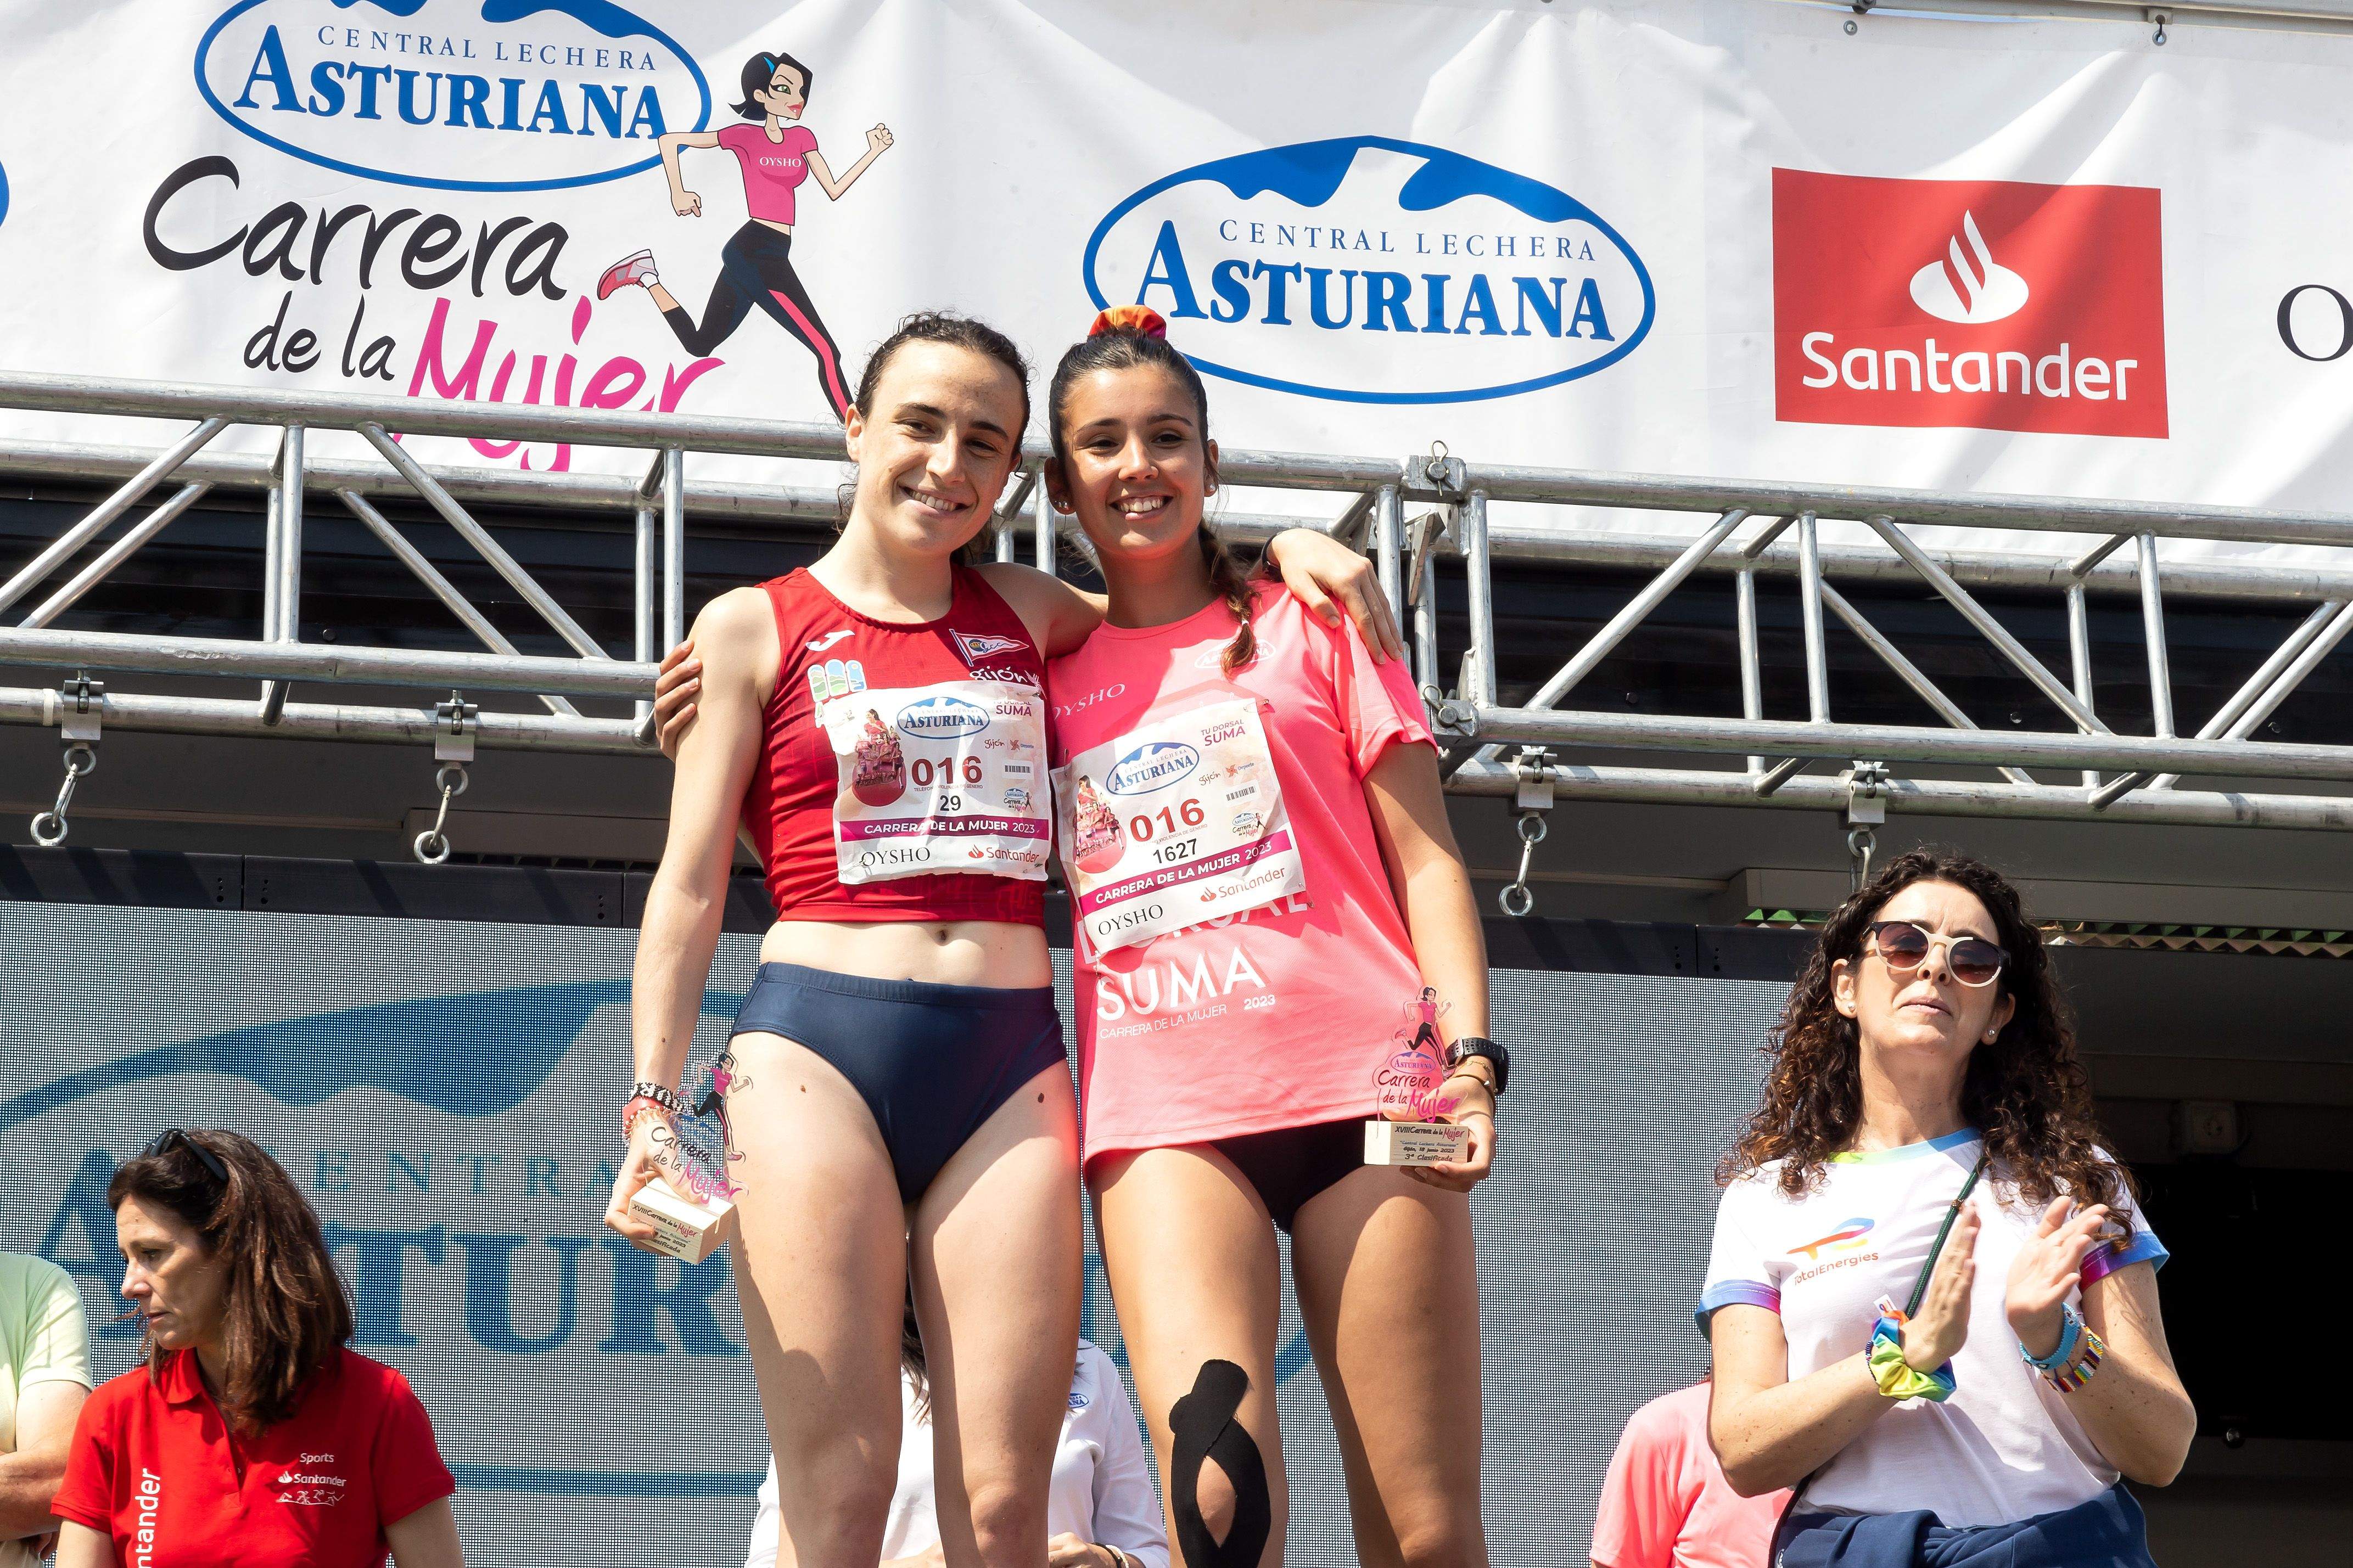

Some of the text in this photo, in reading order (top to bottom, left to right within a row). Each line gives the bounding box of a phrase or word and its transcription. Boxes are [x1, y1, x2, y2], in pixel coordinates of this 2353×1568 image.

[318, 25, 656, 71] CENTRAL LECHERA
[233, 25, 660, 140] ASTURIANA
[759, 155, 802, 168] OYSHO
[143, 156, 568, 300] Carrera
[1219, 218, 1596, 262] CENTRAL LECHERA
[1135, 219, 1615, 342] ASTURIANA
[244, 290, 726, 473] de la Mujer
[1802, 331, 2138, 401] Santander
[904, 712, 984, 729] ASTURIANA
[995, 705, 1032, 717] SUMA
[1213, 719, 1244, 732] DORSAL
[1204, 726, 1246, 746] SUMA
[911, 756, 983, 786] 016
[1114, 755, 1194, 791] ASTURIANA
[939, 795, 961, 811] 29
[1130, 799, 1204, 842] 016
[864, 820, 1035, 834] CARRERA DE LA MUJER 2023
[861, 847, 1039, 867] OYSHO Santander
[1153, 838, 1197, 864] 1627
[1095, 841, 1273, 904] CARRERA DE LA MUJER 2023
[1099, 904, 1164, 935] OYSHO
[1219, 867, 1286, 898] Santander
[1096, 946, 1267, 1021] SUMA
[1100, 994, 1276, 1039] CARRERA DE LA MUJER 2023
[1378, 1070, 1431, 1088] Carrera
[1383, 1088, 1460, 1124] de la Mujer
[651, 1126, 711, 1163] Carrera
[1442, 1127, 1465, 1142] Mujer
[653, 1149, 743, 1204] de la Mujer
[676, 1222, 699, 1238] Mujer
[300, 1453, 334, 1464] Sports
[294, 1473, 346, 1487] Santander
